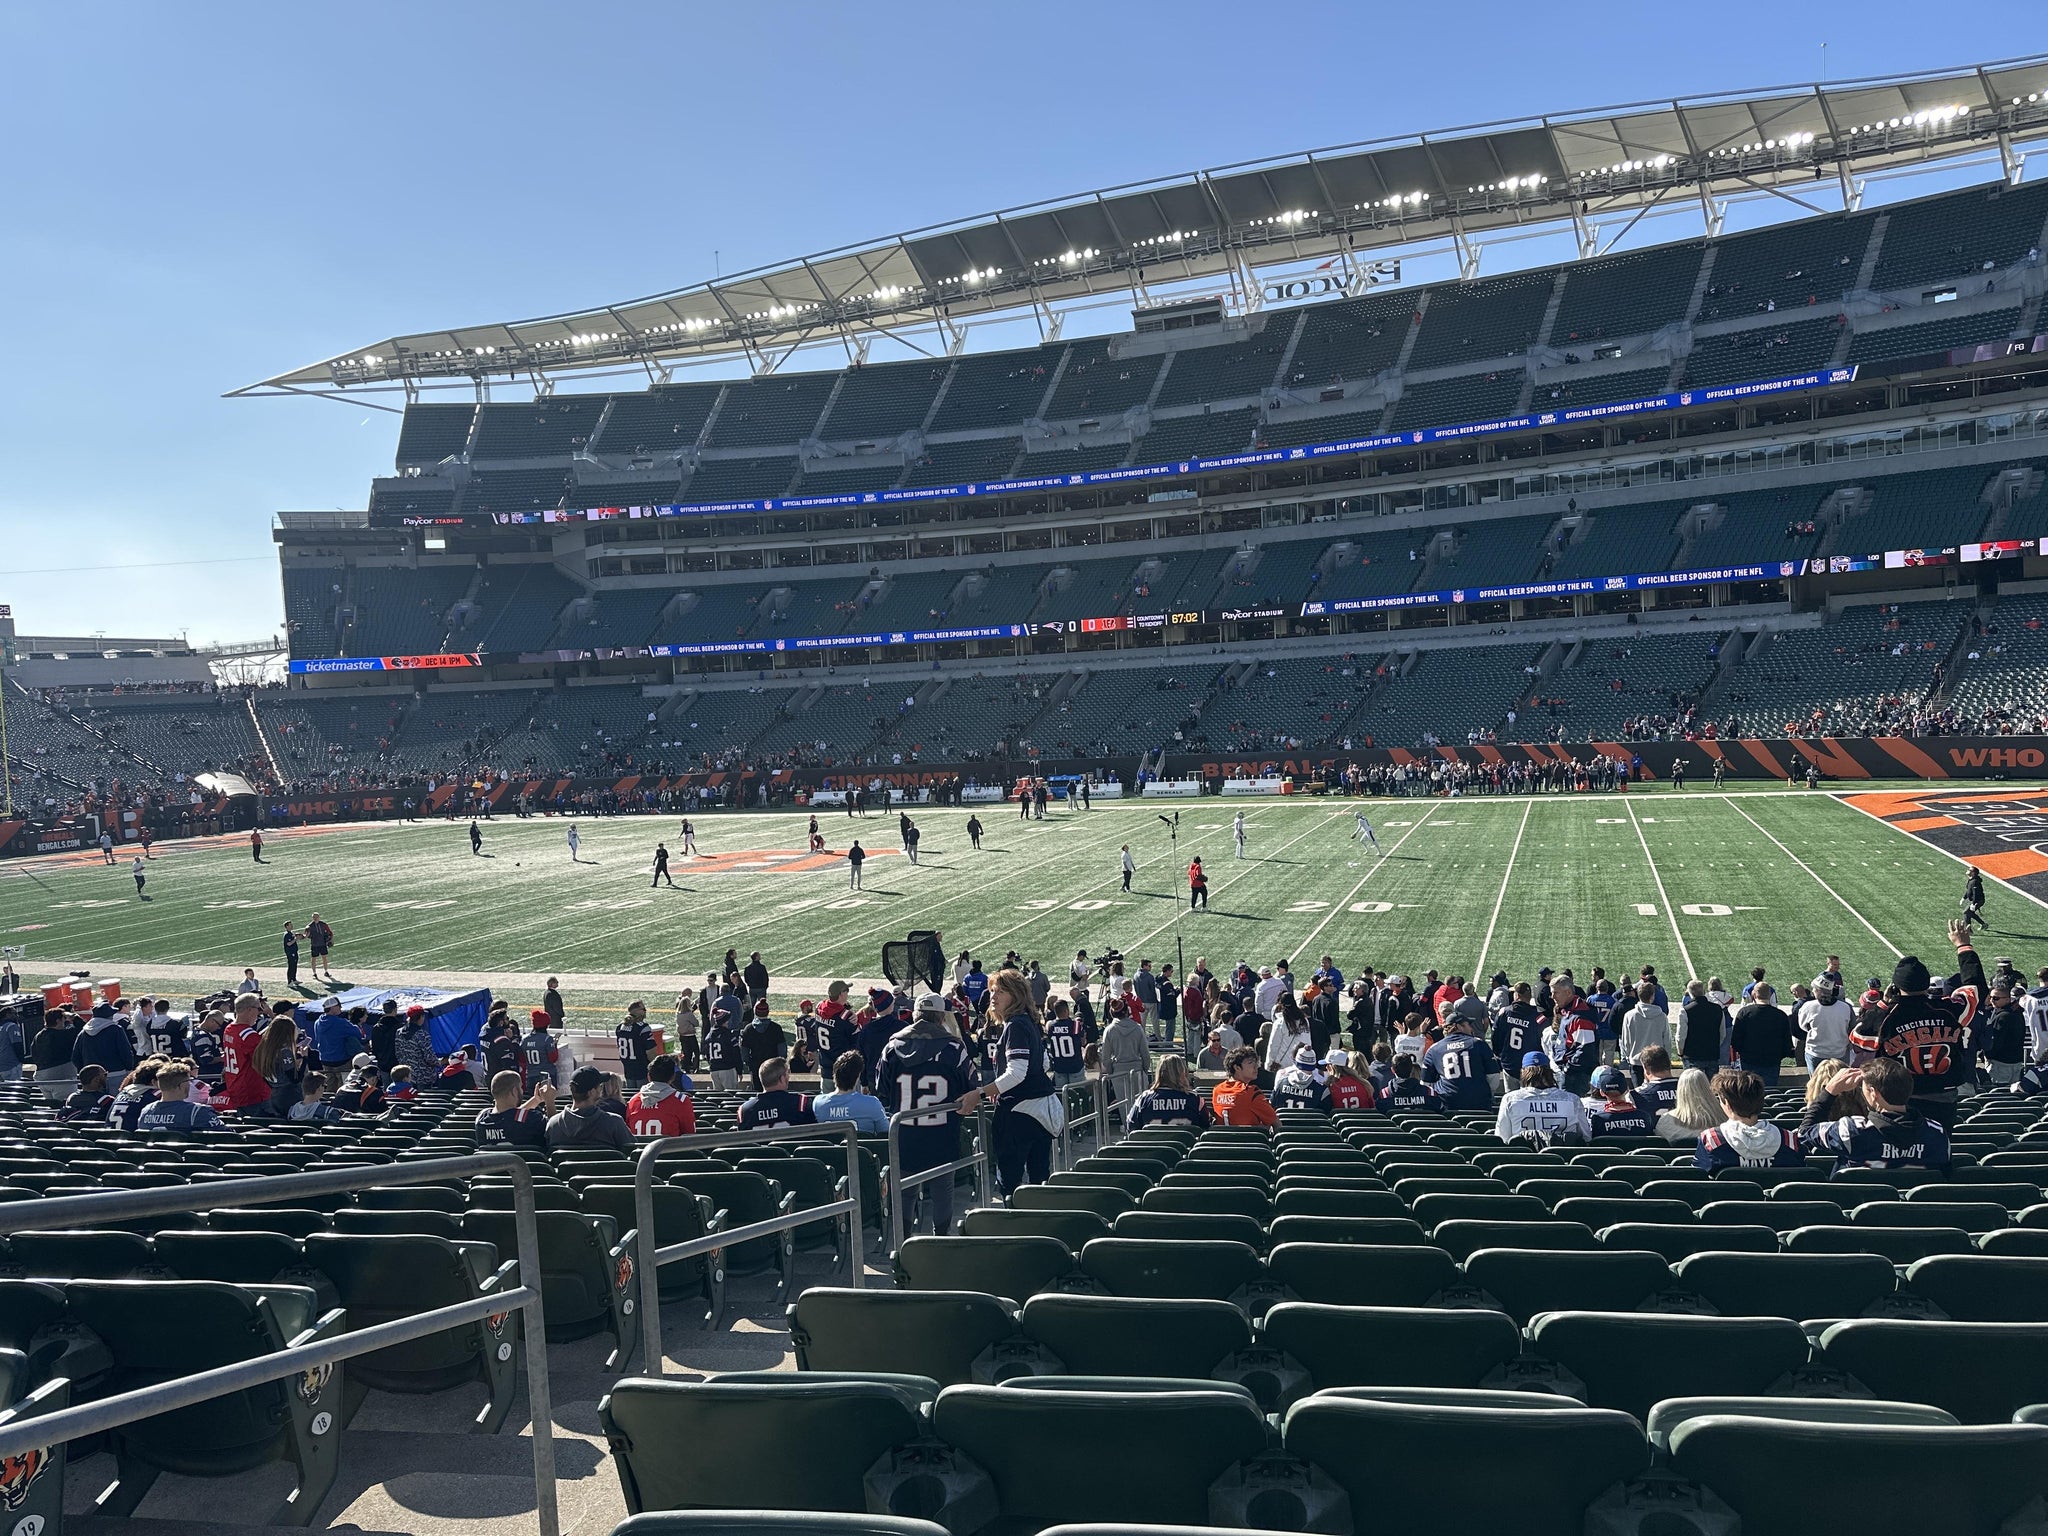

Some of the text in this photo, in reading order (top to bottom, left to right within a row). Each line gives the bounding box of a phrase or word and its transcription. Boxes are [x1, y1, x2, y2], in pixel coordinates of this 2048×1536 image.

[2014, 343, 2025, 351] FG
[1829, 374, 1851, 382] LIGHT
[1706, 376, 1818, 399] OFFICIAL BEER SPONSOR OF THE NFL
[1566, 410, 1591, 419] OFFICIAL
[1592, 408, 1606, 416] BEER
[1607, 404, 1634, 413] SPONSOR
[1435, 429, 1459, 437] OFFICIAL
[1459, 426, 1473, 434] BEER
[1474, 423, 1499, 432] SPONSOR
[1313, 446, 1335, 454] OFFICIAL
[1350, 441, 1373, 449] SPONSOR
[1233, 456, 1255, 464] SPONSOR
[403, 517, 434, 527] Paycor
[1638, 567, 1763, 585] OFFICIAL BEER SPONSOR OF THE NFL
[1479, 589, 1508, 598] OFFICIAL
[1509, 588, 1525, 596] BEER
[1526, 585, 1556, 594] SPONSOR
[1605, 582, 1626, 590] LIGHT
[1334, 602, 1360, 610] OFFICIAL
[1361, 600, 1376, 608] BEER
[1377, 598, 1405, 606] SPONSOR
[1136, 614, 1165, 622] COUNTDOWN
[1171, 612, 1199, 624] 67:02
[1222, 609, 1284, 621] Paycor STADIUM
[1068, 621, 1077, 632] 0
[1088, 619, 1096, 630] 0
[1144, 620, 1164, 628] KICKOFF
[305, 660, 375, 672] ticketmaster
[425, 656, 462, 667] DEC 14 1PM
[1949, 748, 2045, 768] WHO
[1202, 757, 1334, 778] BENGALS
[37, 838, 82, 852] BENGALS.COM
[1283, 901, 1395, 913] 20
[1629, 902, 1733, 916] 10
[1507, 1016, 1531, 1028] GONZALEZ
[1895, 1018, 1945, 1034] CINCINNATI
[1052, 1026, 1069, 1034] JONES
[150, 1034, 173, 1054] 12
[817, 1026, 831, 1051] 6
[1509, 1027, 1524, 1051] 6
[618, 1037, 637, 1060] 81
[709, 1042, 723, 1062] 12
[1050, 1035, 1075, 1058] 10
[1447, 1041, 1465, 1051] MOSS
[224, 1046, 240, 1076] 12
[526, 1049, 541, 1065] 10
[1442, 1050, 1473, 1080] 81
[1282, 1084, 1314, 1098] EDELMAN
[1341, 1085, 1357, 1094] BRADY
[1656, 1090, 1678, 1102] BRA
[897, 1073, 949, 1127] 12
[1152, 1098, 1187, 1111] BRADY
[1216, 1094, 1236, 1106] CHASE
[1394, 1096, 1426, 1106] EDELMAN
[829, 1107, 850, 1118] MAYE
[1529, 1102, 1558, 1114] ALLEN
[109, 1104, 130, 1130] 5
[143, 1113, 175, 1124] GONZALEZ
[757, 1108, 779, 1122] ELLIS
[1520, 1116, 1568, 1134] 17
[1604, 1118, 1646, 1132] PATRIOTS
[485, 1128, 506, 1141] MAYE
[501, 1345, 510, 1357] 17
[317, 1416, 328, 1431] 18
[21, 1524, 37, 1536] 19
